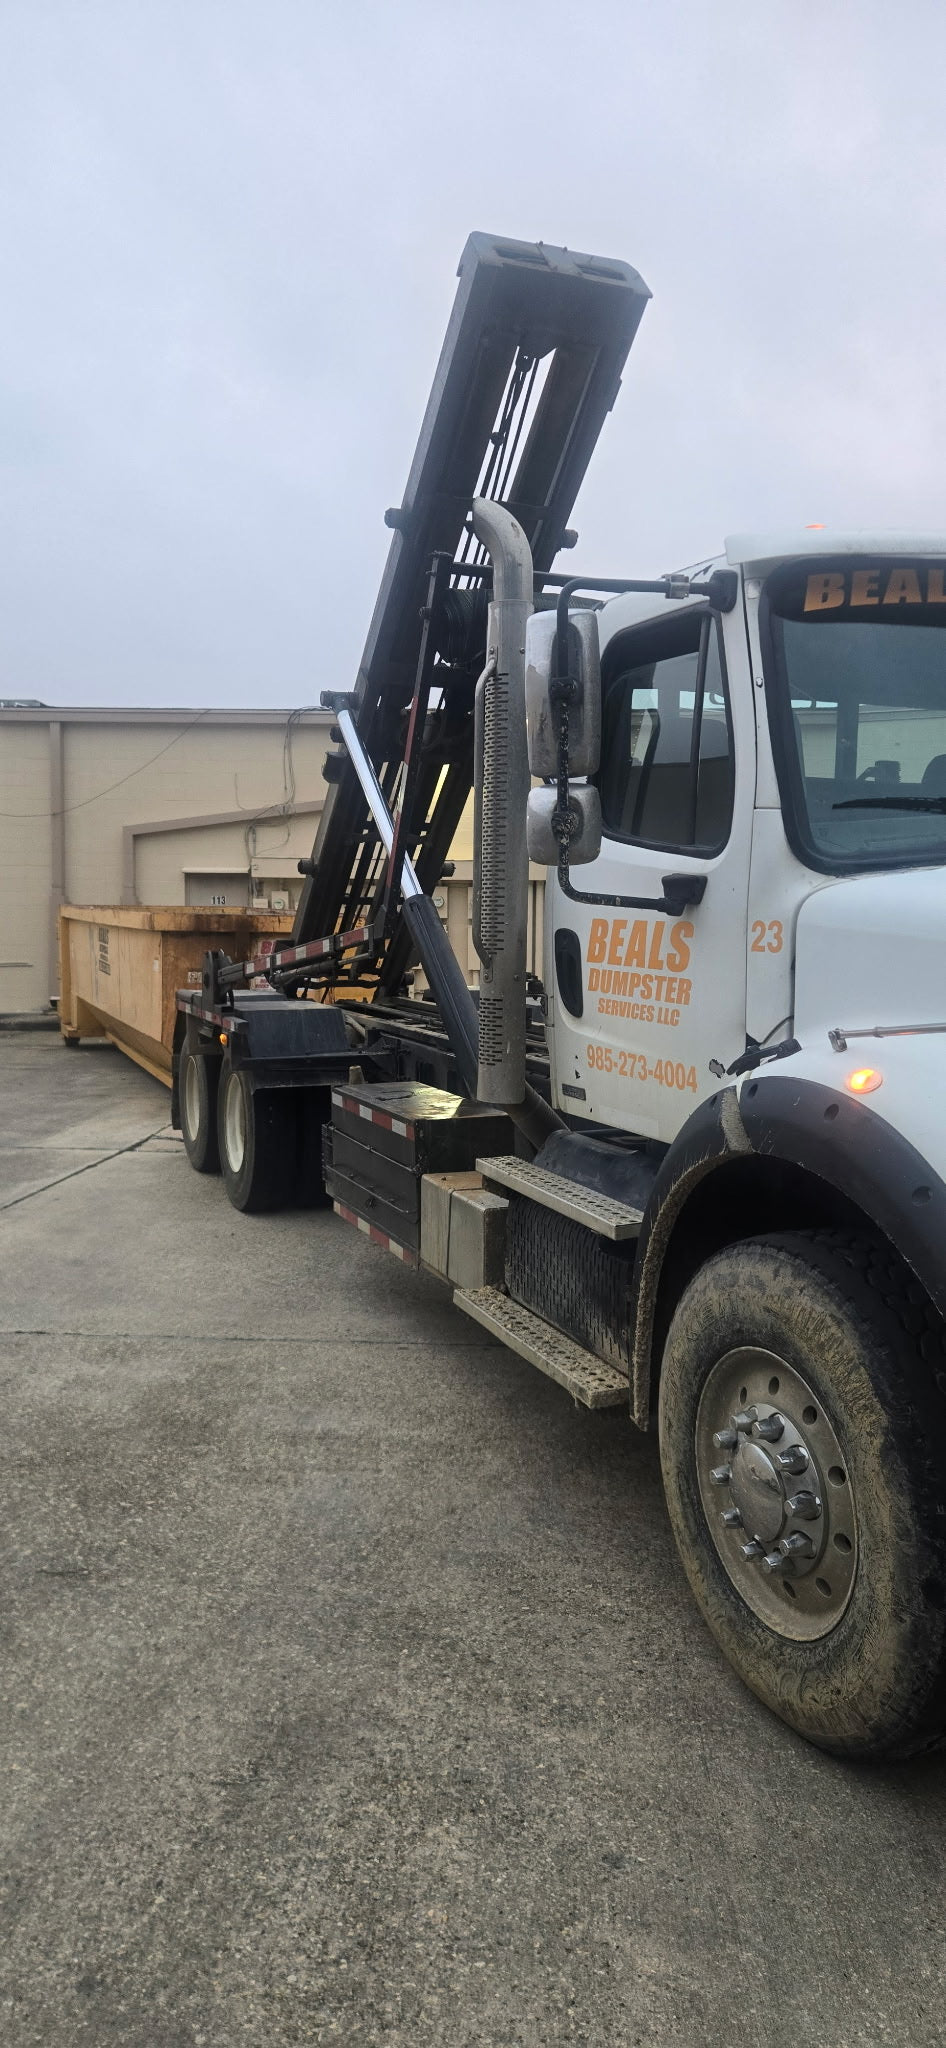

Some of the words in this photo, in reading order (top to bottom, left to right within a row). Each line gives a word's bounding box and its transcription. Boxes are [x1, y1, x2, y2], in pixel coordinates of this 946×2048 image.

[212, 896, 226, 904] 113
[587, 918, 695, 972] BEALS
[751, 920, 784, 953] 23
[587, 968, 692, 1005] DUMPSTER
[597, 998, 655, 1022] SERVICES
[657, 1008, 681, 1026] LLC
[586, 1044, 698, 1093] 985-273-4004
